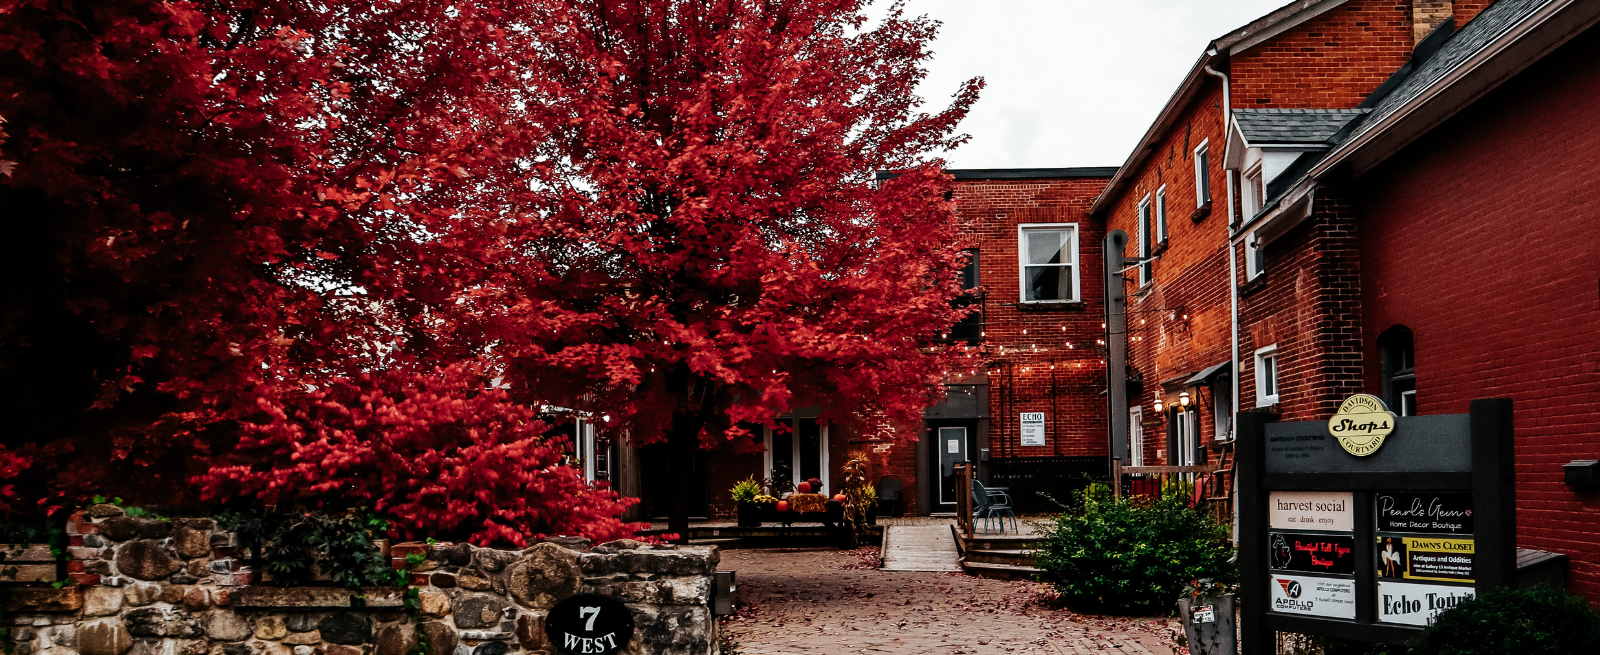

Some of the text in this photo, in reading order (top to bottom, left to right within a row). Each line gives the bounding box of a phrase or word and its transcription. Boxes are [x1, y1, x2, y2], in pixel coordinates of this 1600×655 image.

[1342, 397, 1378, 412] DAVIDSON
[1332, 419, 1390, 433] Shops
[1342, 436, 1380, 453] COURTYARD
[1277, 499, 1345, 512] harvest social
[1380, 496, 1464, 520] Pearl's Gem
[1432, 522, 1462, 531] Boutique
[1295, 540, 1350, 557] Beautiful Full Figure
[1312, 555, 1334, 569] Boutique
[1276, 598, 1314, 607] APOLLO
[1383, 594, 1421, 615] Echo
[580, 606, 601, 631] 7
[564, 632, 617, 654] WEST
